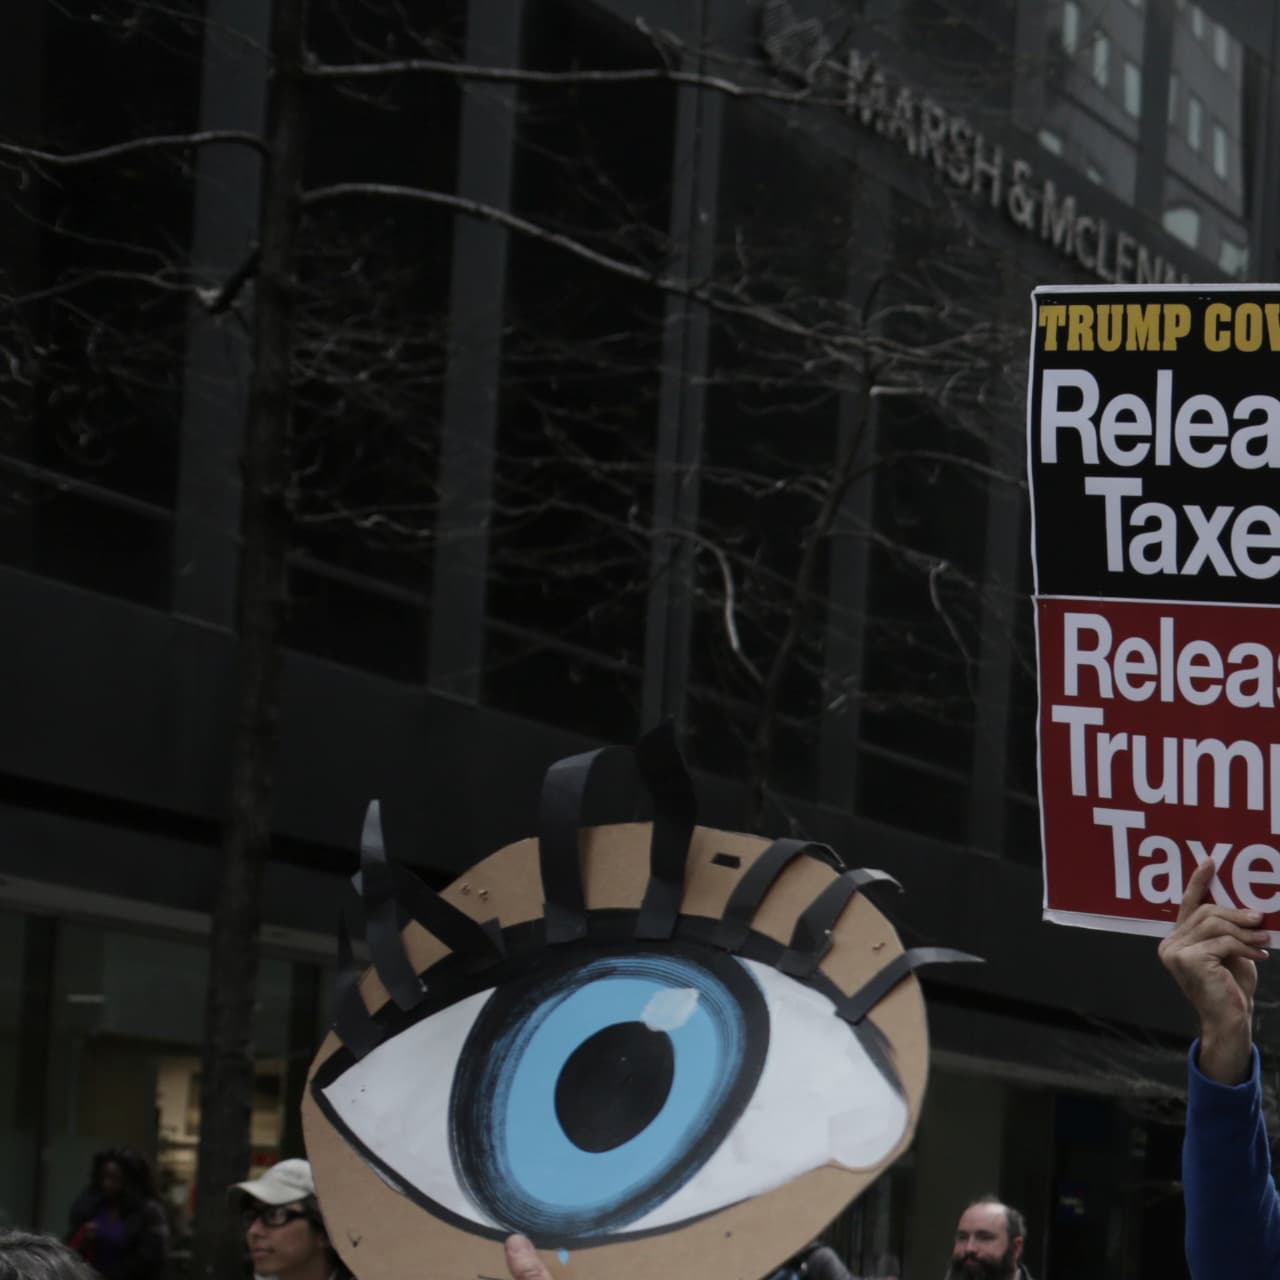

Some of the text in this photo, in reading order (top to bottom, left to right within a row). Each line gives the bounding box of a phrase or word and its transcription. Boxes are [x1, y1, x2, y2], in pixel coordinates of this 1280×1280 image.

[847, 48, 1002, 207] MARSH
[1007, 158, 1035, 231] &
[1038, 303, 1191, 352] TRUMP
